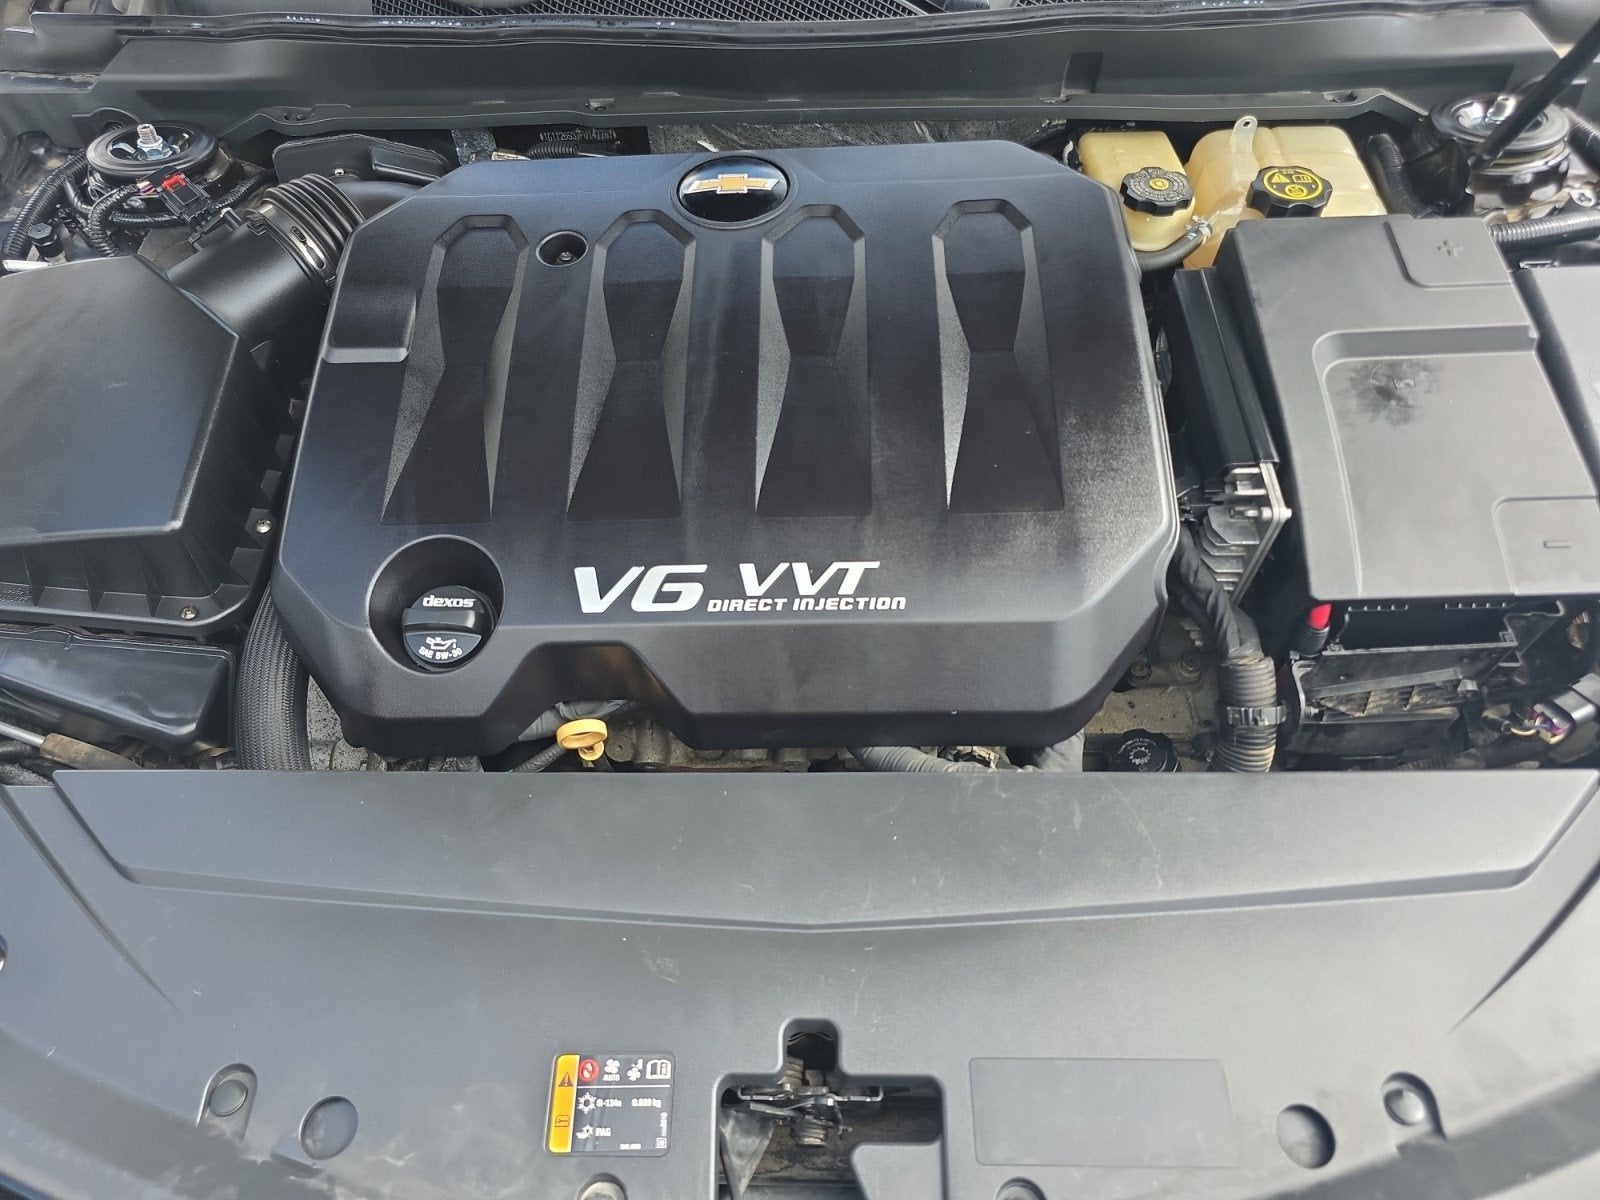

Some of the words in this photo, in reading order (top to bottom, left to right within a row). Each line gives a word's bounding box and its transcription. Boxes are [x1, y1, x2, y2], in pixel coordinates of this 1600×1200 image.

[574, 564, 708, 613] V6
[739, 561, 881, 596] VVT
[422, 594, 477, 608] dexos
[707, 597, 788, 613] DIRECT
[793, 596, 907, 611] INJECTION
[418, 646, 435, 660] SAE
[435, 647, 463, 660] 5W-30
[602, 1073, 621, 1082] AUTO
